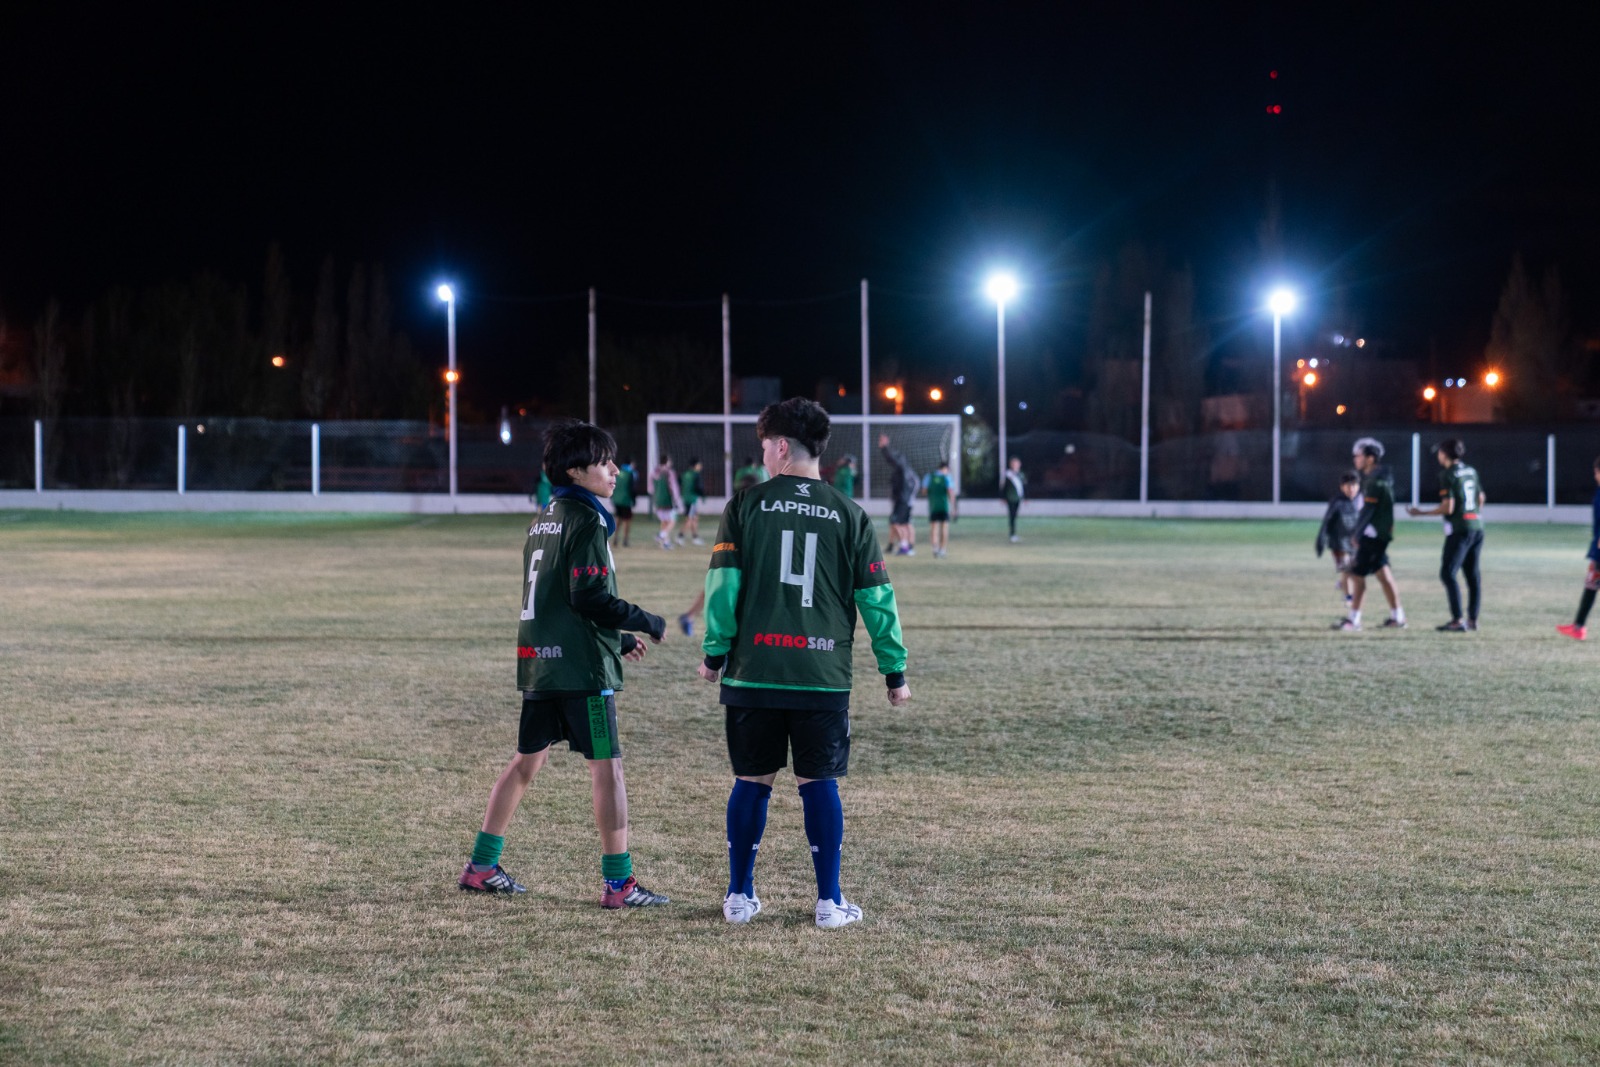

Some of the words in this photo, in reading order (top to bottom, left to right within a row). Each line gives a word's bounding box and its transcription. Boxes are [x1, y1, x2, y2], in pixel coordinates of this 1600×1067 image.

[761, 500, 841, 523] LAPRIDA
[529, 522, 562, 536] LAPRDA
[780, 530, 818, 608] 4
[754, 633, 835, 651] PETROSAR
